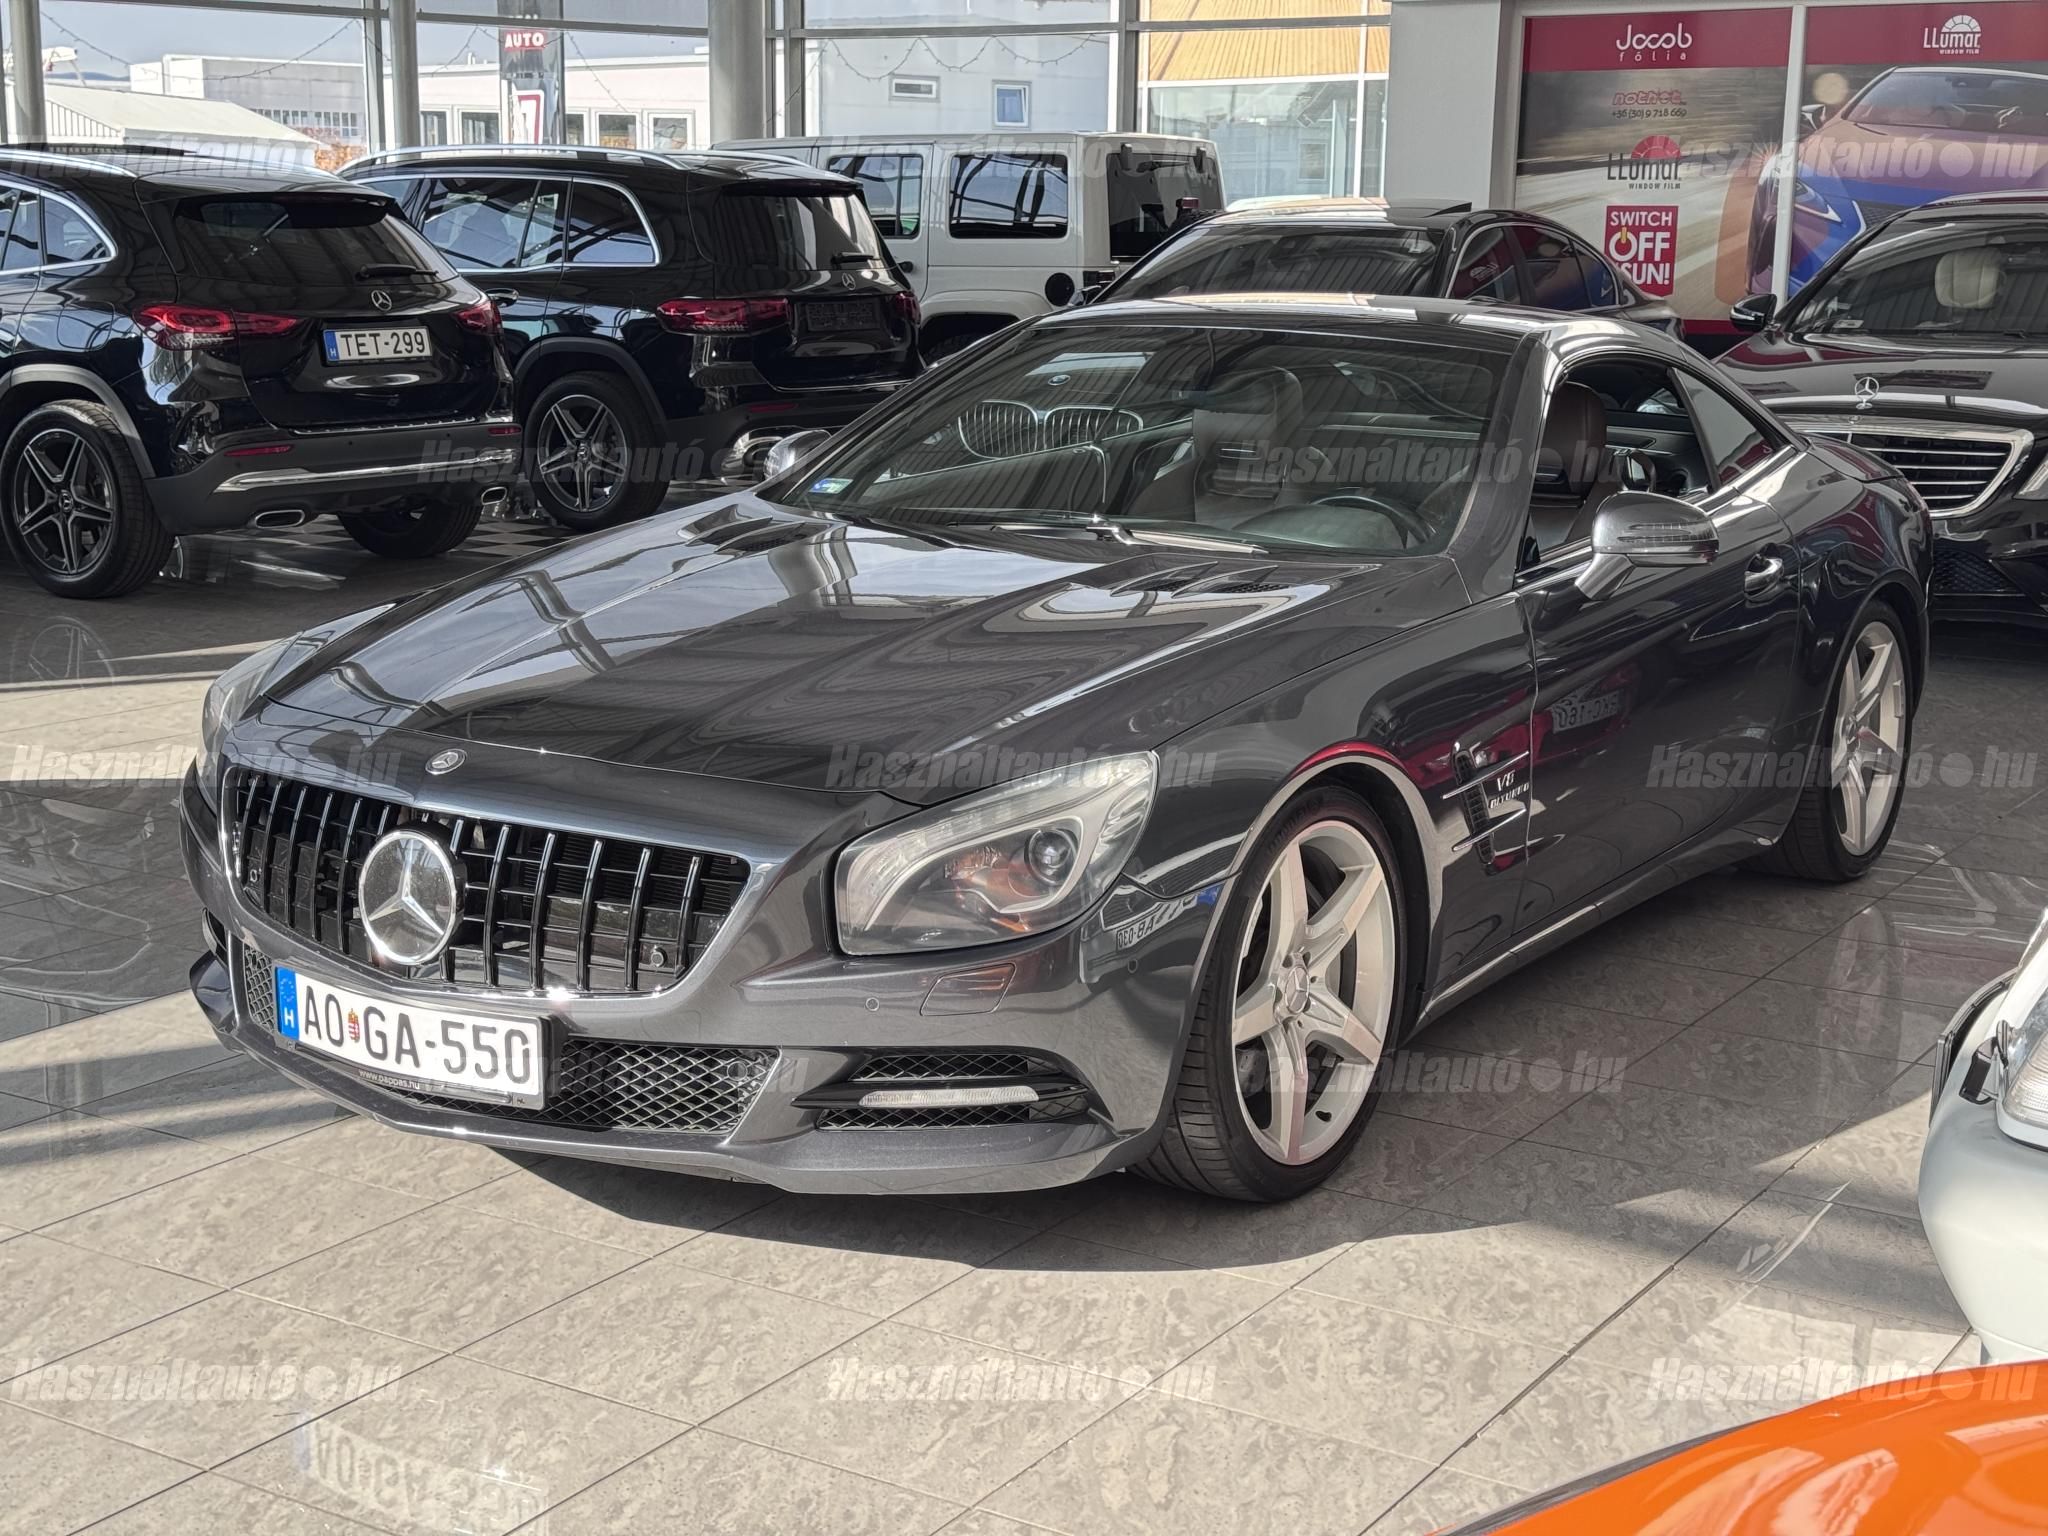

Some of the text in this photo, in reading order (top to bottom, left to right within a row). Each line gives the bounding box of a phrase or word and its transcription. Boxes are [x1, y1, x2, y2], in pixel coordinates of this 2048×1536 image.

[504, 32, 545, 48] AUTO
[1923, 27, 1981, 48] LLumar
[1607, 153, 1681, 180] LLumar
[1610, 211, 1673, 227] SWITCH
[1609, 230, 1671, 262] OFF
[340, 331, 426, 357] TET-299
[284, 1007, 295, 1028] H
[304, 985, 344, 1047] AO
[363, 1005, 531, 1084] GA-550
